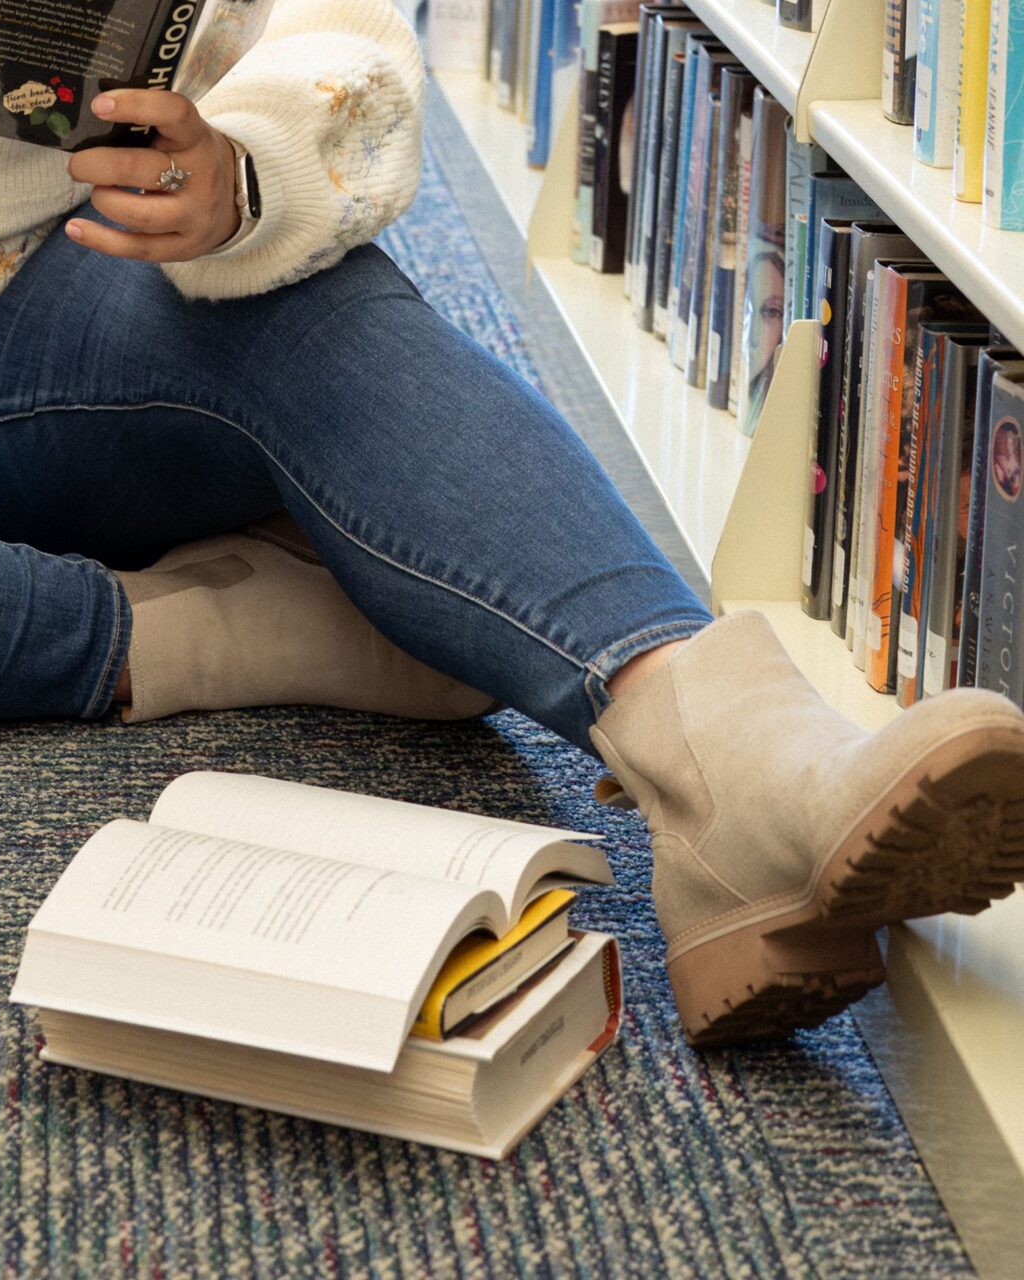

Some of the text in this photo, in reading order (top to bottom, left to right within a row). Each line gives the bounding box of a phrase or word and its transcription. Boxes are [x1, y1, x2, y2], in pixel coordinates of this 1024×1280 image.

[989, 22, 999, 75] TALK
[130, 63, 175, 136] HT
[598, 51, 613, 111] SULLY
[986, 87, 997, 151] JEANNIE
[902, 347, 925, 593] AMONG THE LIVING AND THE DEAD
